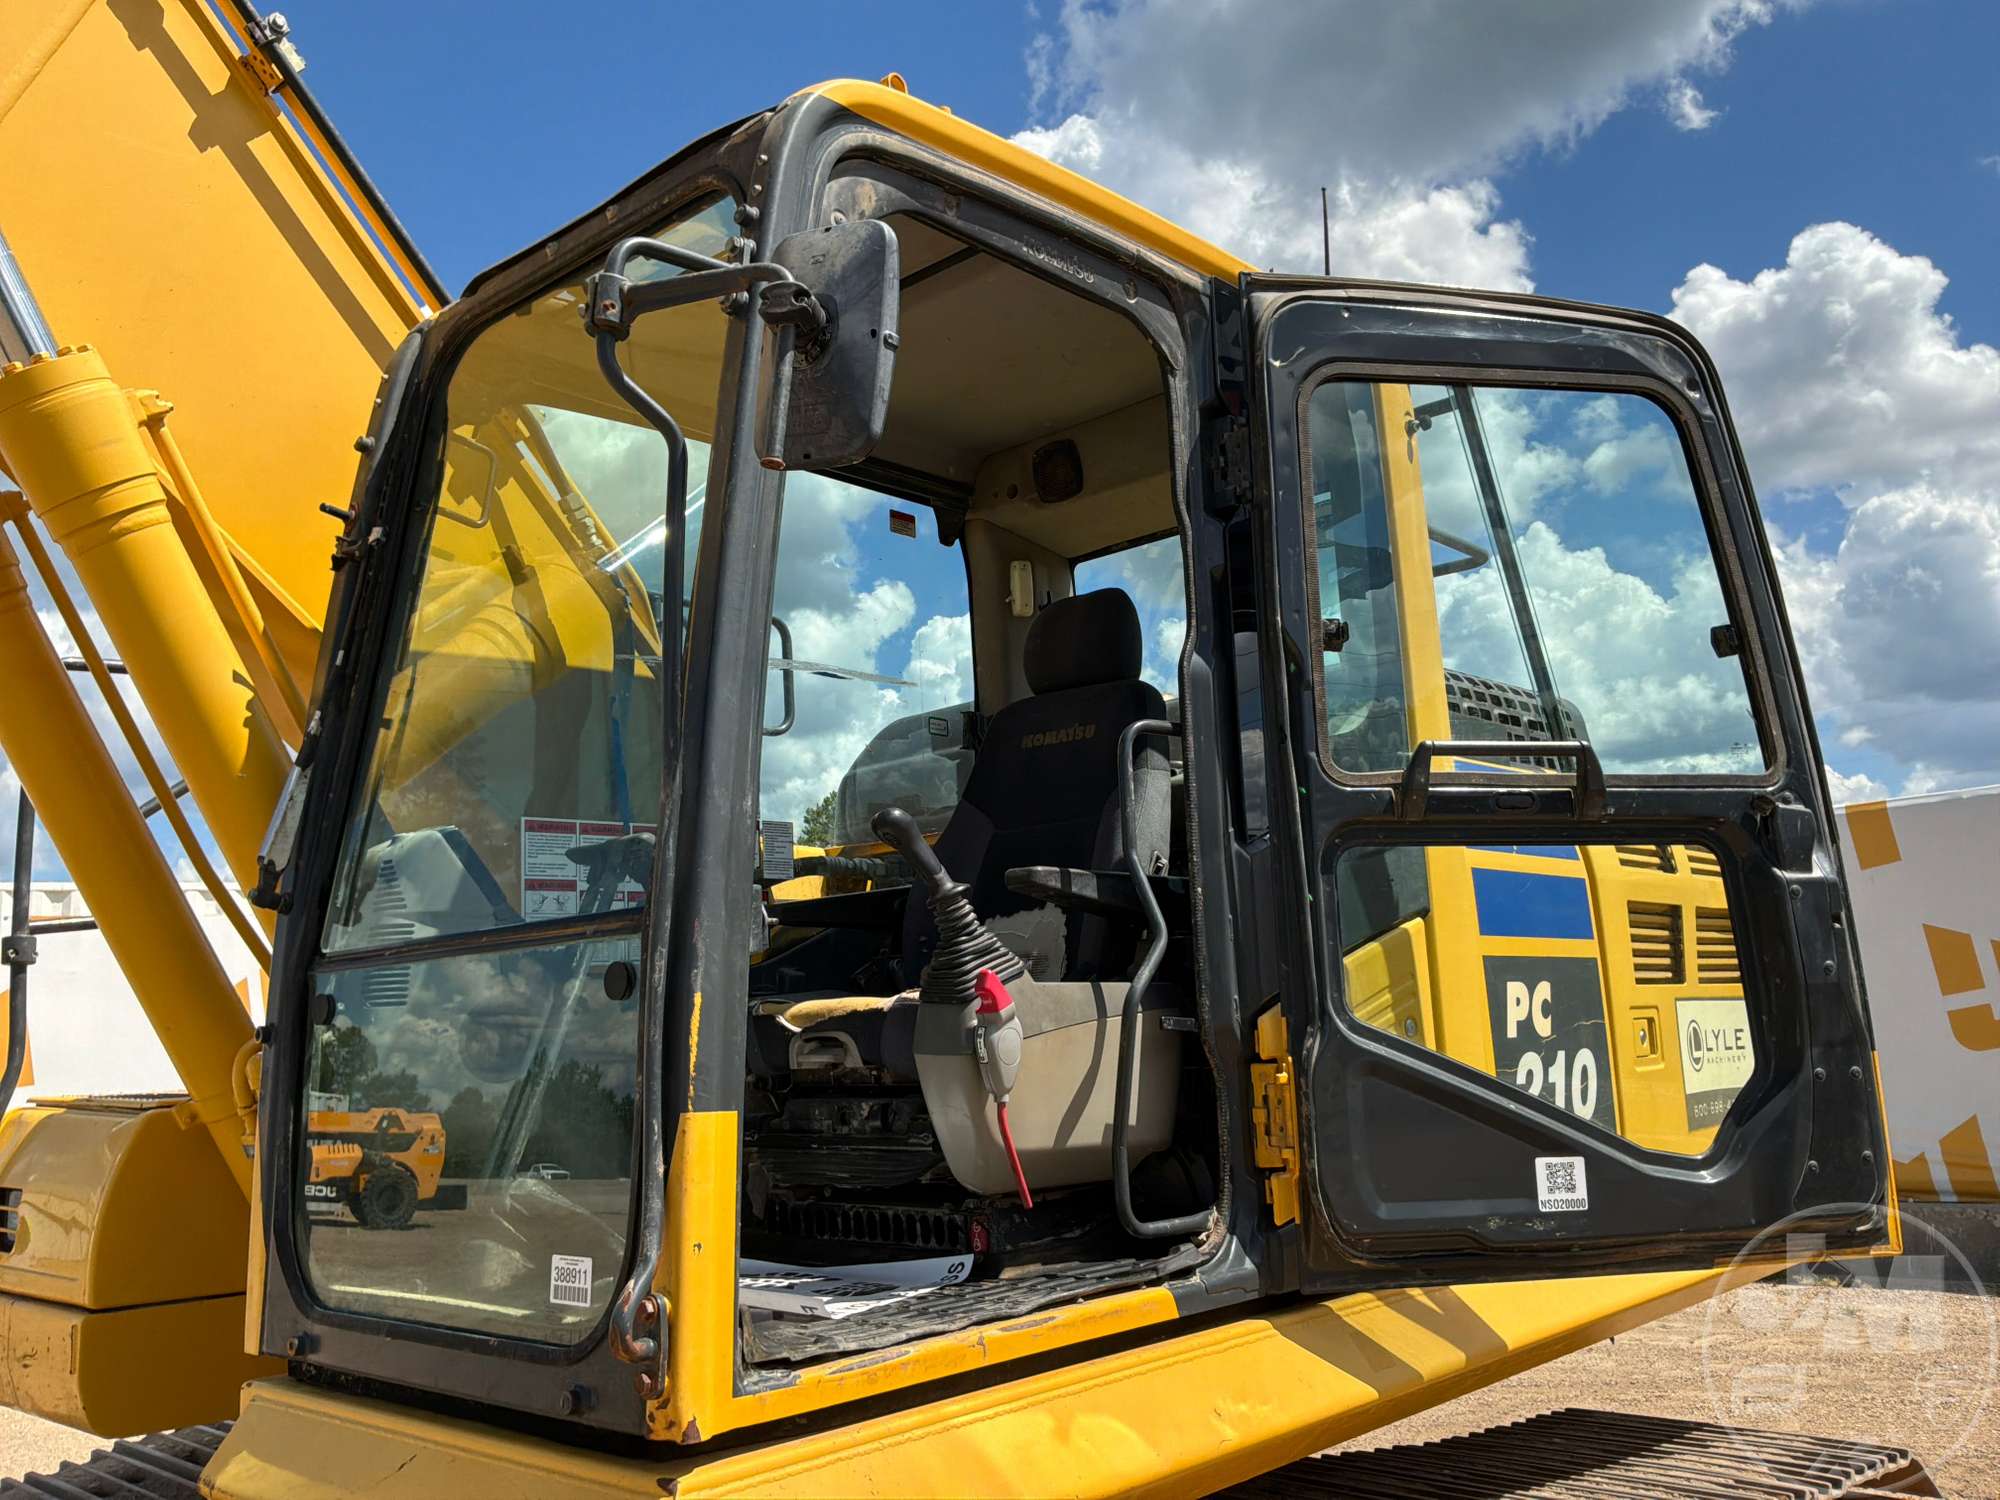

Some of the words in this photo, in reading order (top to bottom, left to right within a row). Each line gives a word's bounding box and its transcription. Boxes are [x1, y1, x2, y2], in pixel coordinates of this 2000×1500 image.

[1506, 980, 1552, 1039] PC
[1704, 1028, 1746, 1052] LYLE
[1516, 1048, 1598, 1121] 210
[553, 1266, 588, 1286] 388911
